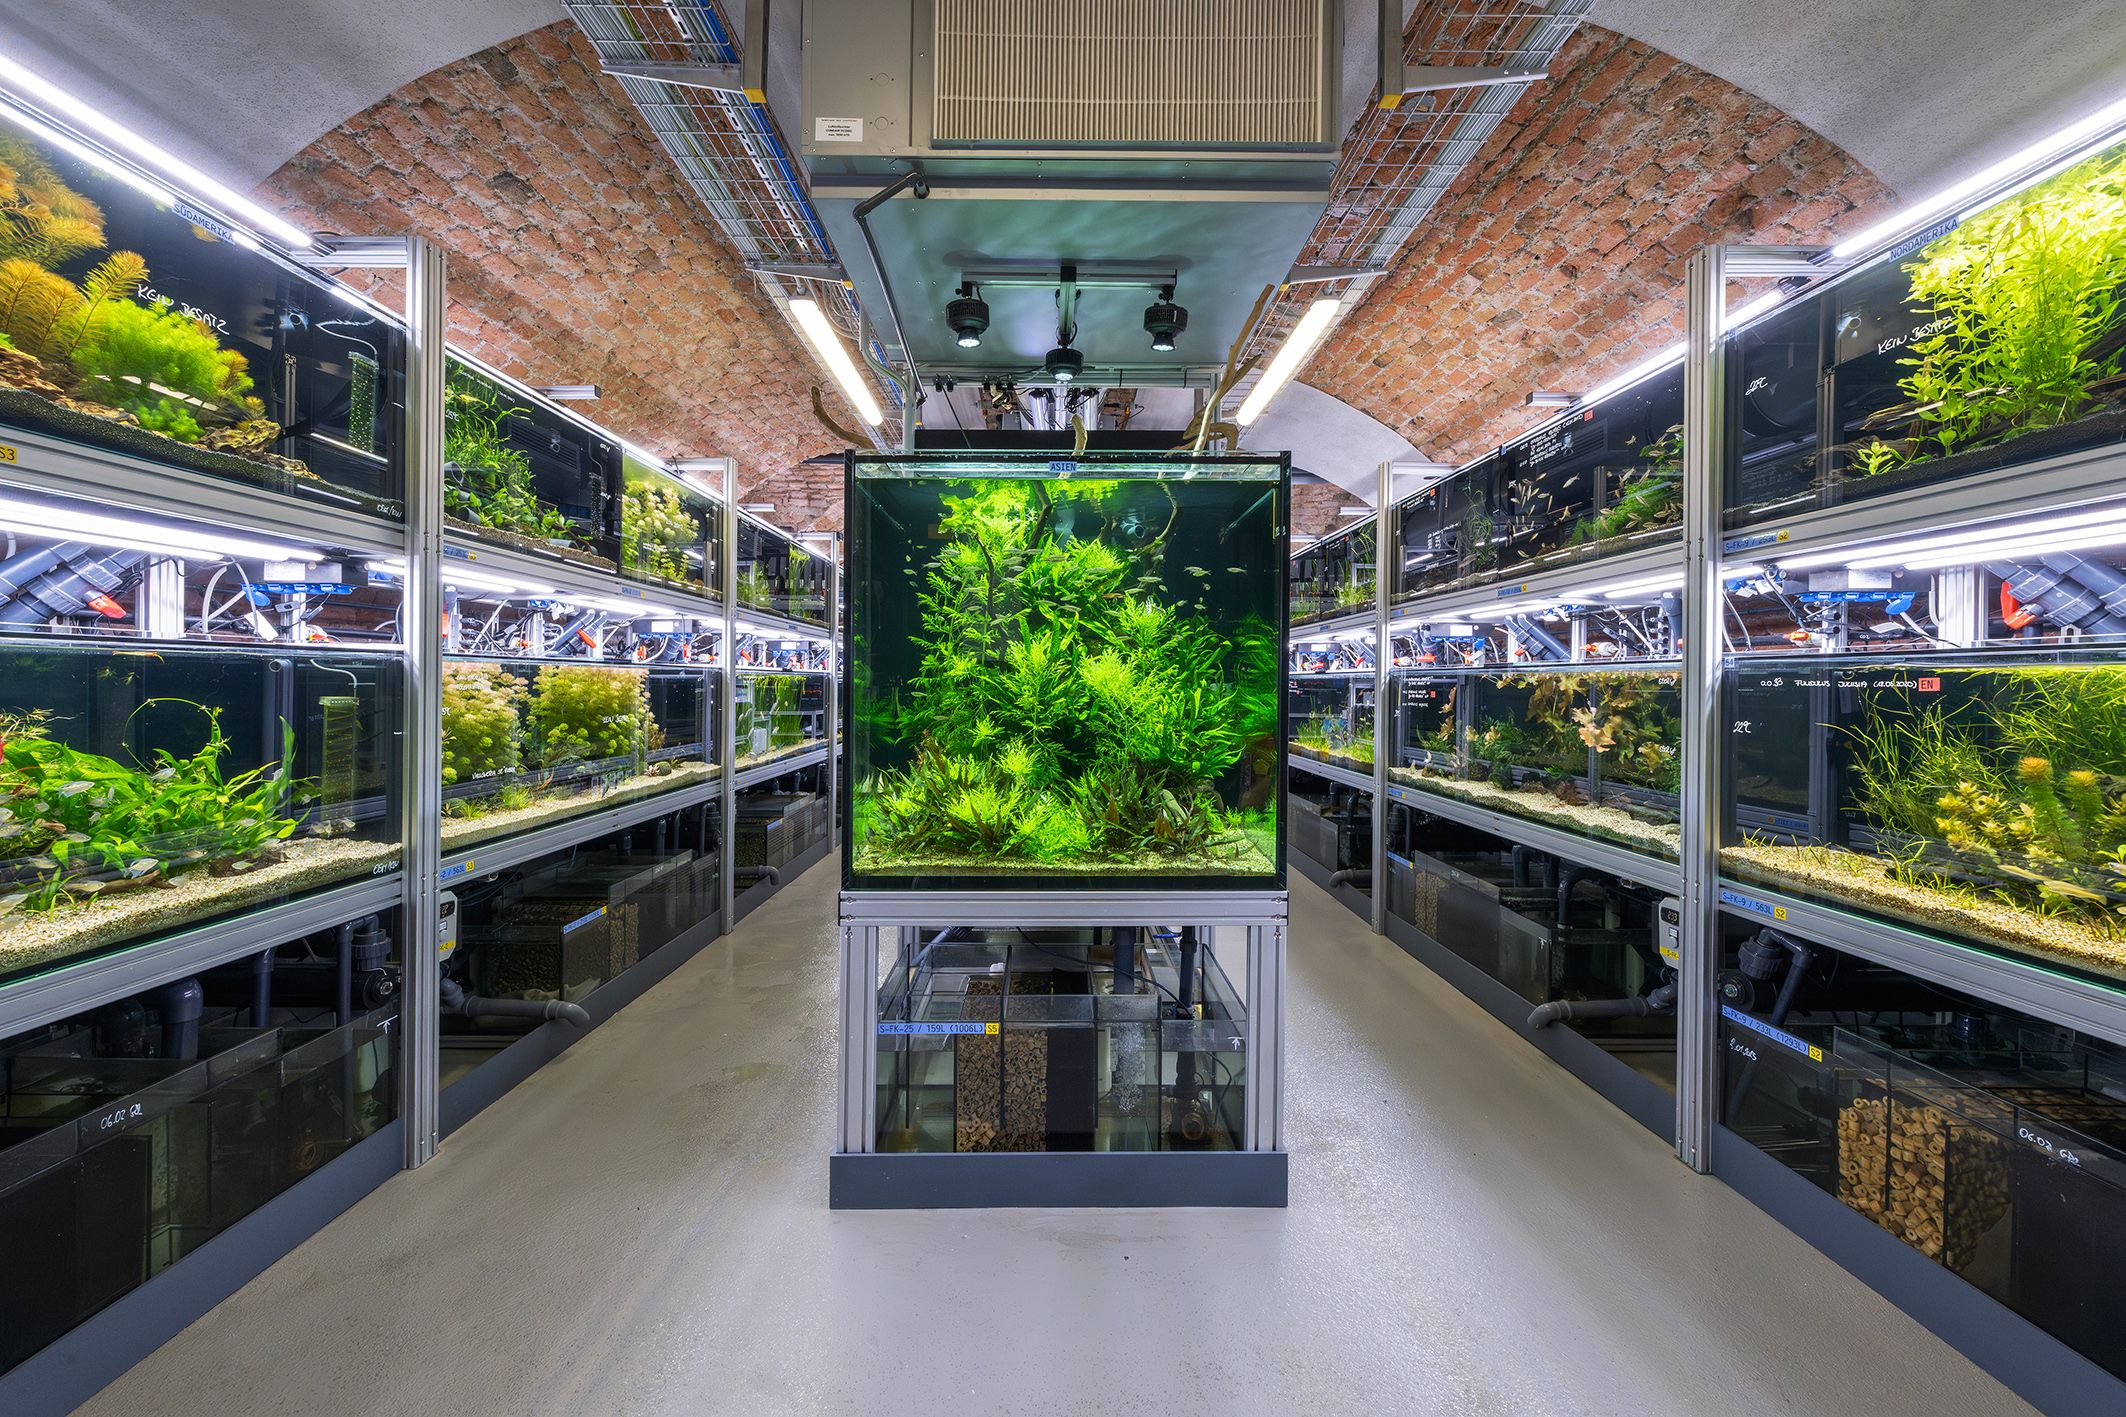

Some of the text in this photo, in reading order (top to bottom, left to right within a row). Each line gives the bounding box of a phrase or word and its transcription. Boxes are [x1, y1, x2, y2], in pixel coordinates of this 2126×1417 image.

[174, 203, 234, 243] SÜDAMERIKA
[1890, 218, 1958, 260] NORDAMERIKA
[138, 284, 174, 306] KEIN
[1878, 335, 1907, 355] KEIN
[1050, 463, 1076, 471] ASIEN
[1921, 680, 1934, 689] EN
[1722, 891, 1746, 906] S-FK-9
[1755, 902, 1773, 915] 563L
[1775, 908, 1785, 918] S2
[880, 1024, 914, 1032] S-FK-25
[927, 1024, 945, 1032] 159L
[949, 1024, 984, 1033] (1006L)
[987, 1024, 998, 1033] S5
[1723, 1006, 1747, 1024] S-FK-9
[1755, 1022, 1773, 1037] 233L
[1776, 1031, 1807, 1052] (1293L)
[1810, 1048, 1821, 1059] S2
